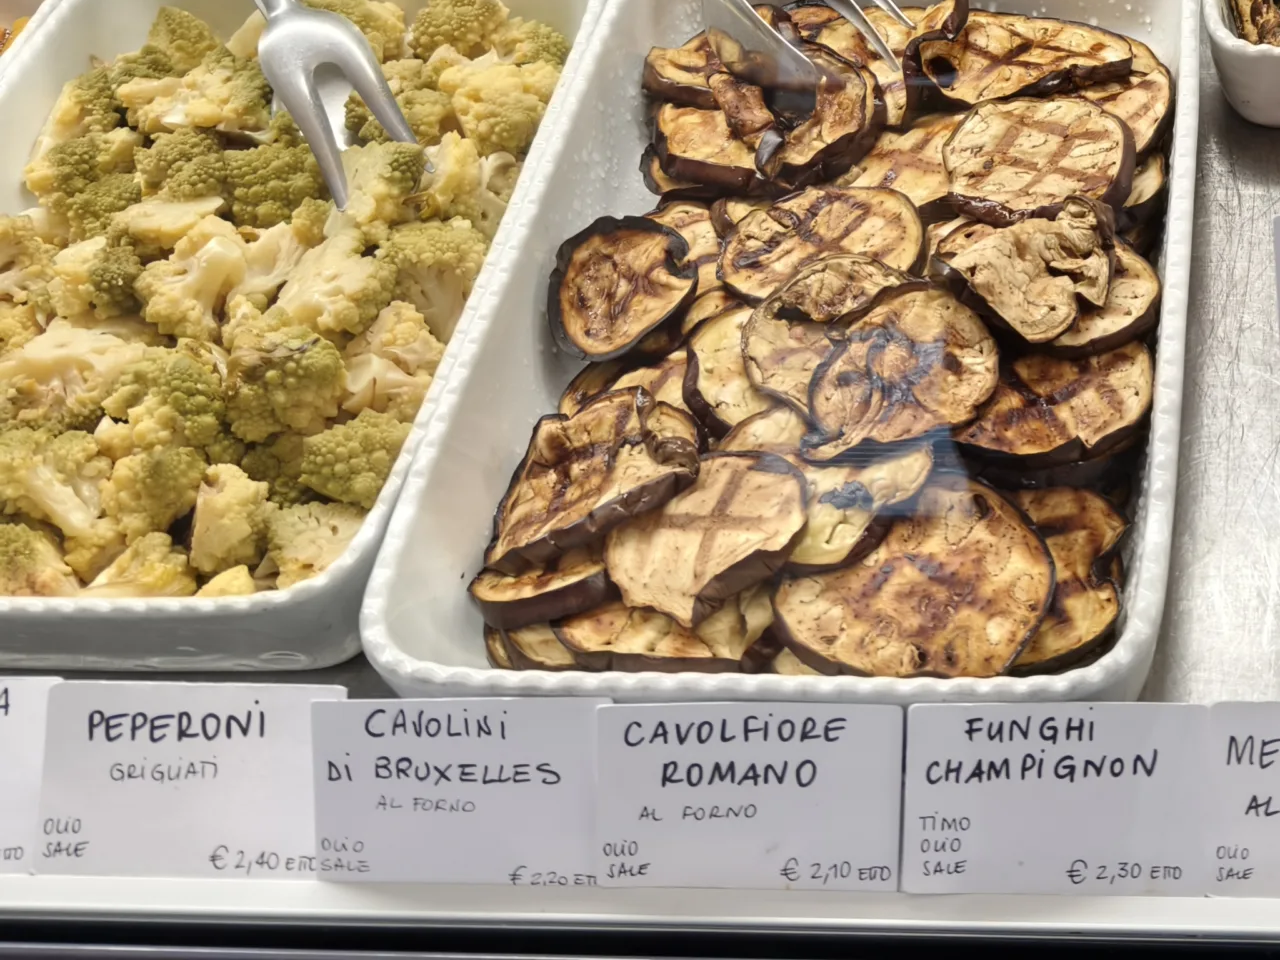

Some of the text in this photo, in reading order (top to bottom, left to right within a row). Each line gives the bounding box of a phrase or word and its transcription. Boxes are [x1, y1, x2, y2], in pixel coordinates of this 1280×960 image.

[87, 699, 266, 743] PEPERONI
[364, 708, 508, 740] CAVOLINI
[623, 713, 848, 747] CAVOLFIORE
[964, 706, 1095, 746] FUNGHI
[109, 755, 219, 783] GRIGLIATI
[375, 755, 561, 786] BRUXELLES
[661, 758, 818, 788] ROMANO
[925, 748, 1158, 785] CHAMPIGNON
[375, 795, 476, 813] AL FORNO
[638, 803, 757, 822] AL FORNO
[1244, 794, 1280, 818] AL
[43, 816, 82, 835] OLIO
[918, 811, 971, 833] TIMO
[42, 841, 90, 858] SALE
[321, 837, 365, 853] OLIO
[602, 839, 639, 858] OLIO
[920, 837, 962, 854] OLIO
[1215, 844, 1250, 861] OLIO
[234, 850, 281, 876] 2,40
[320, 857, 372, 873] SALE
[606, 862, 652, 880] SALE
[810, 860, 852, 886] 2,10
[857, 865, 892, 882] ETTO
[922, 859, 968, 877] SALE
[1095, 862, 1143, 886] 2,30
[1150, 865, 1184, 881] ETTO
[1215, 866, 1254, 882] SALE
